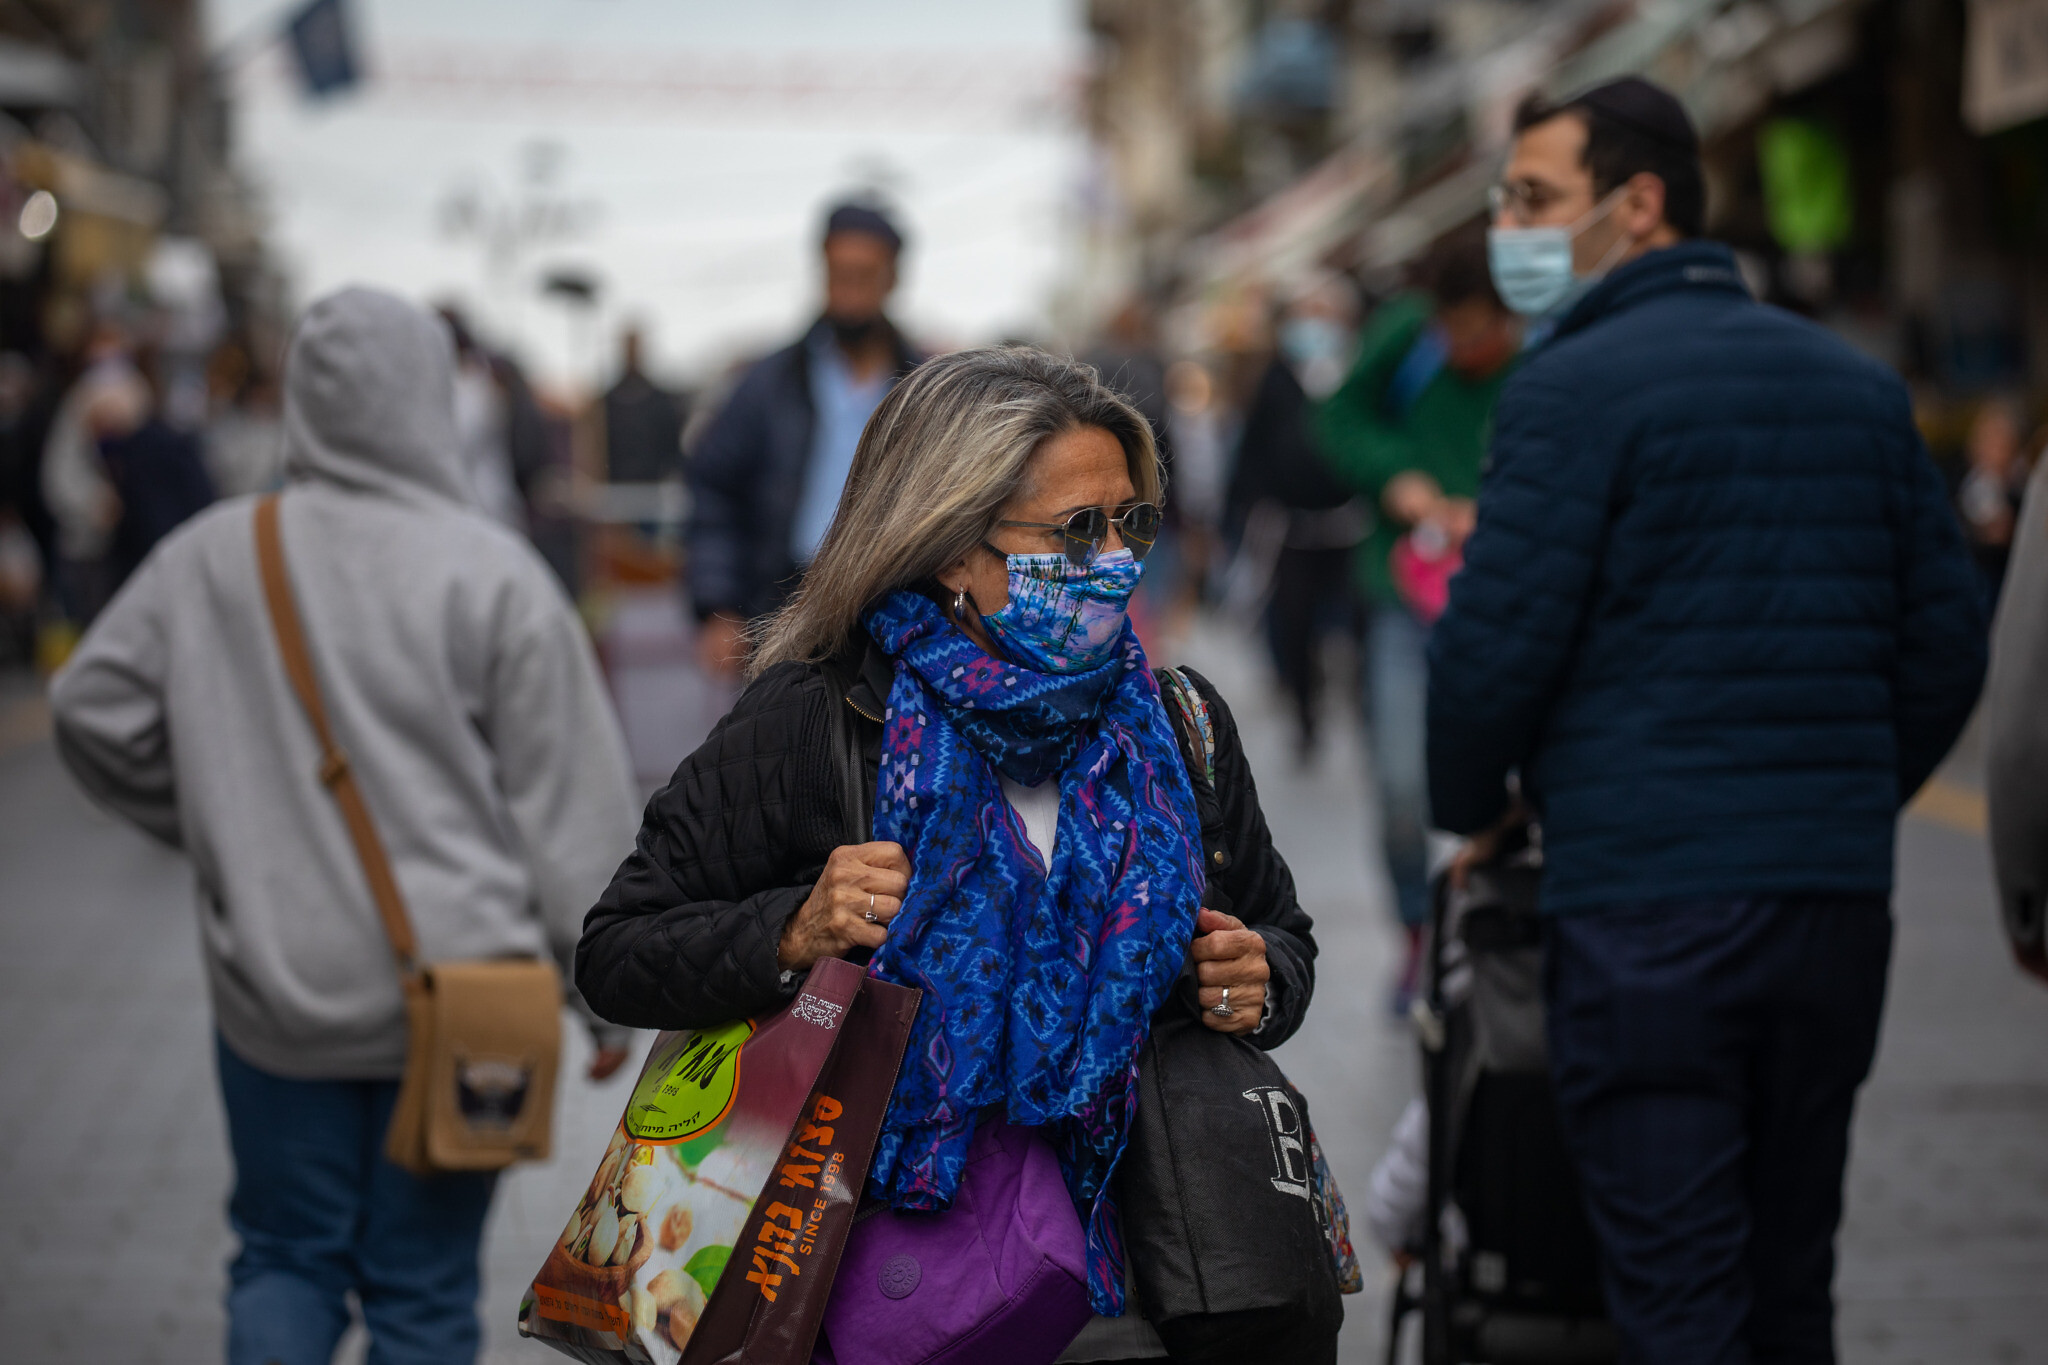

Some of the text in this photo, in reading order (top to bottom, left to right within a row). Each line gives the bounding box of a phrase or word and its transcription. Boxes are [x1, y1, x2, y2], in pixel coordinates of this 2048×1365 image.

[668, 1110, 701, 1132] קליה
[800, 1152, 845, 1256] SINCE 1998
